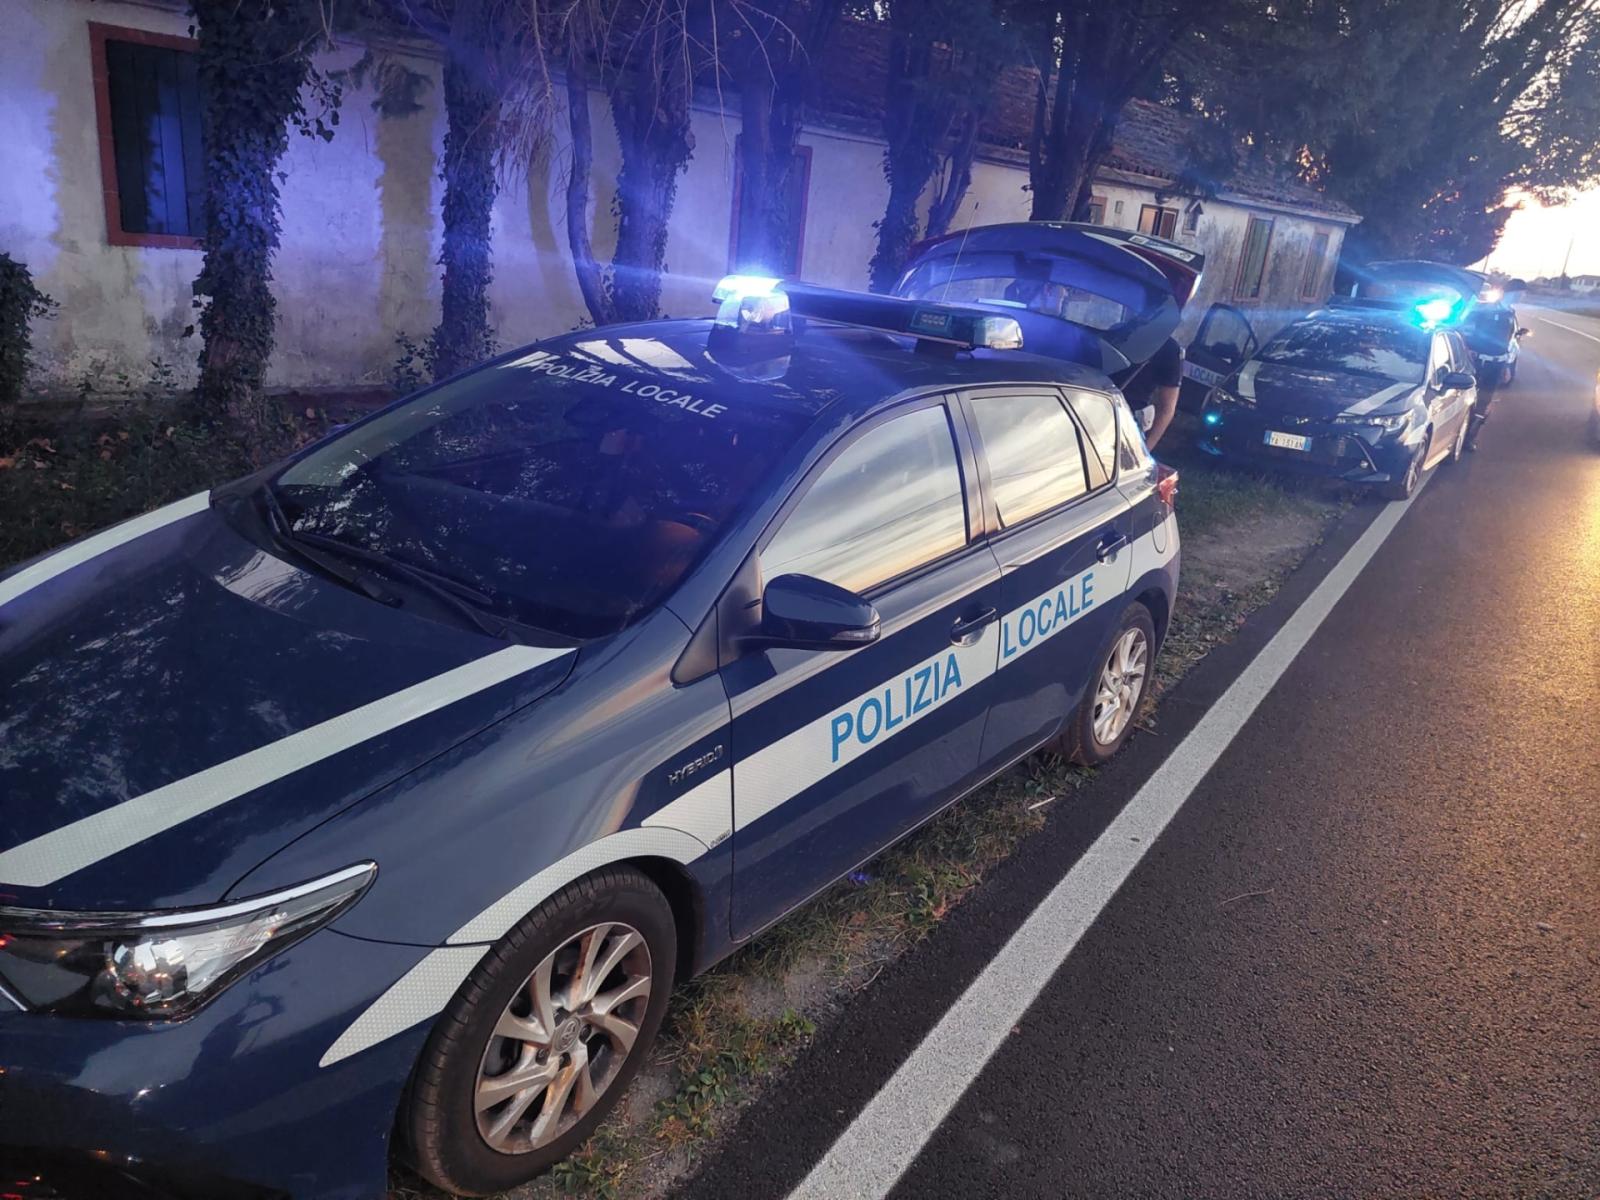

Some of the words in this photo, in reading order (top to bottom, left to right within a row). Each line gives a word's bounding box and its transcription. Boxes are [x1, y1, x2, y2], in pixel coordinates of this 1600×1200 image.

[531, 362, 617, 387] POLIZIA
[620, 380, 728, 418] LOCALE
[831, 653, 962, 763] POLIZIA
[1003, 573, 1094, 658] LOCALE
[667, 751, 715, 786] HYBRID
